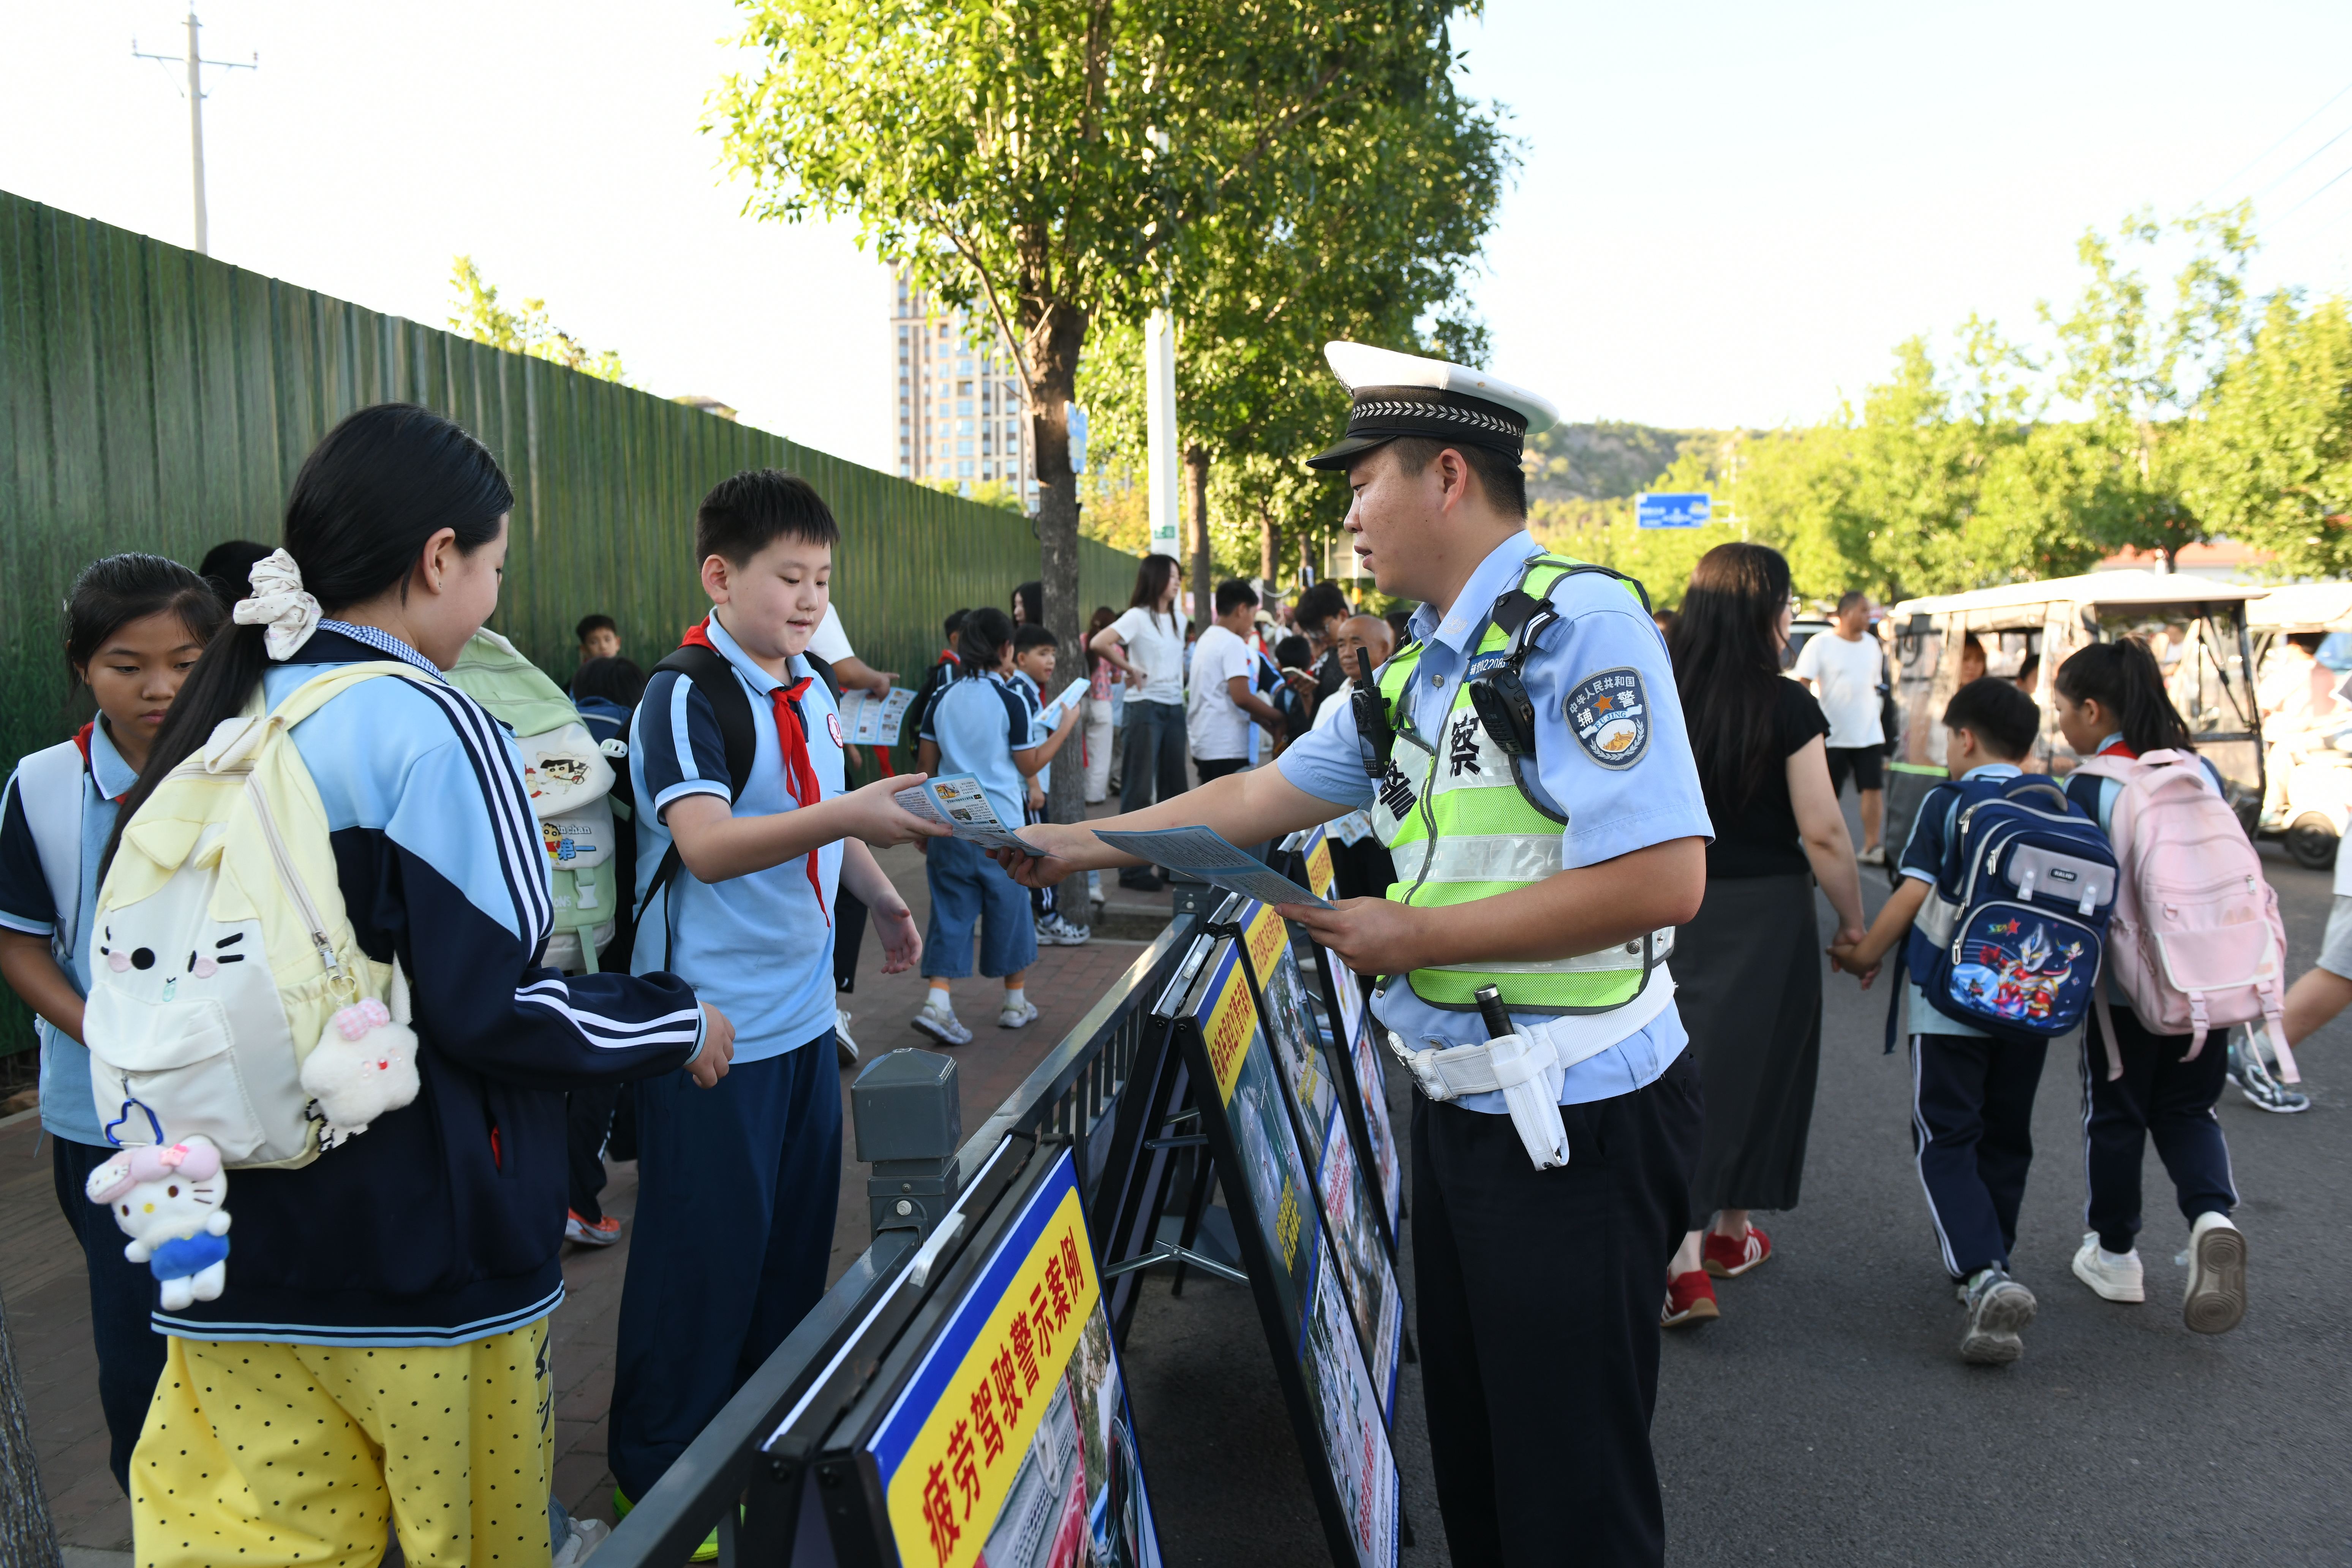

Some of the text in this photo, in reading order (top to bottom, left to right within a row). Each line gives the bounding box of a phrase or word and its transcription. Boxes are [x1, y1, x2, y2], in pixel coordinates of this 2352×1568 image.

[1569, 676, 1635, 714] 中华人民共和国
[1577, 690, 1635, 727] 辅 警
[1595, 711, 1626, 730] FU JING
[568, 825, 591, 834] chan
[559, 838, 596, 860] 第一
[1210, 973, 1252, 1086] 电动车闯红灯警示案例
[923, 1226, 1085, 1567] 疲劳驾驶警示案例
